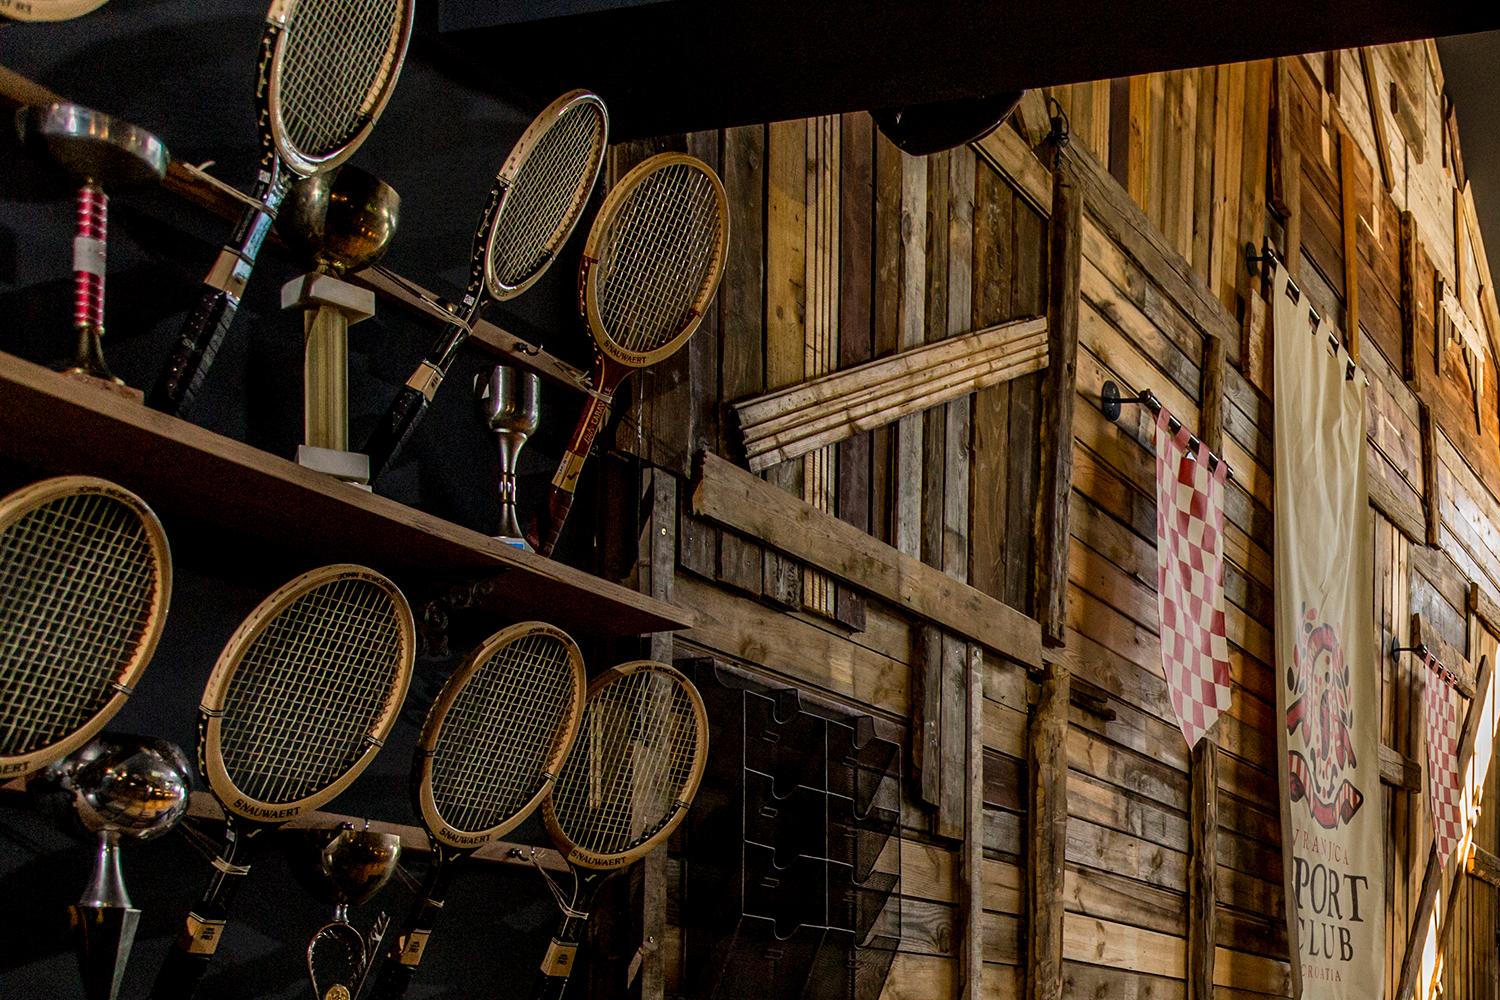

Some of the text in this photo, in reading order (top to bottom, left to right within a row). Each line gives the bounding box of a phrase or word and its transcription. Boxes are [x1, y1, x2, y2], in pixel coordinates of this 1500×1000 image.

[604, 341, 646, 364] SNAUWAERT
[233, 798, 301, 819] SNAUWAERT
[439, 827, 491, 845] SNAUWAERT
[571, 849, 626, 867] SNAUWAERT
[1301, 962, 1341, 982] CROATIA
